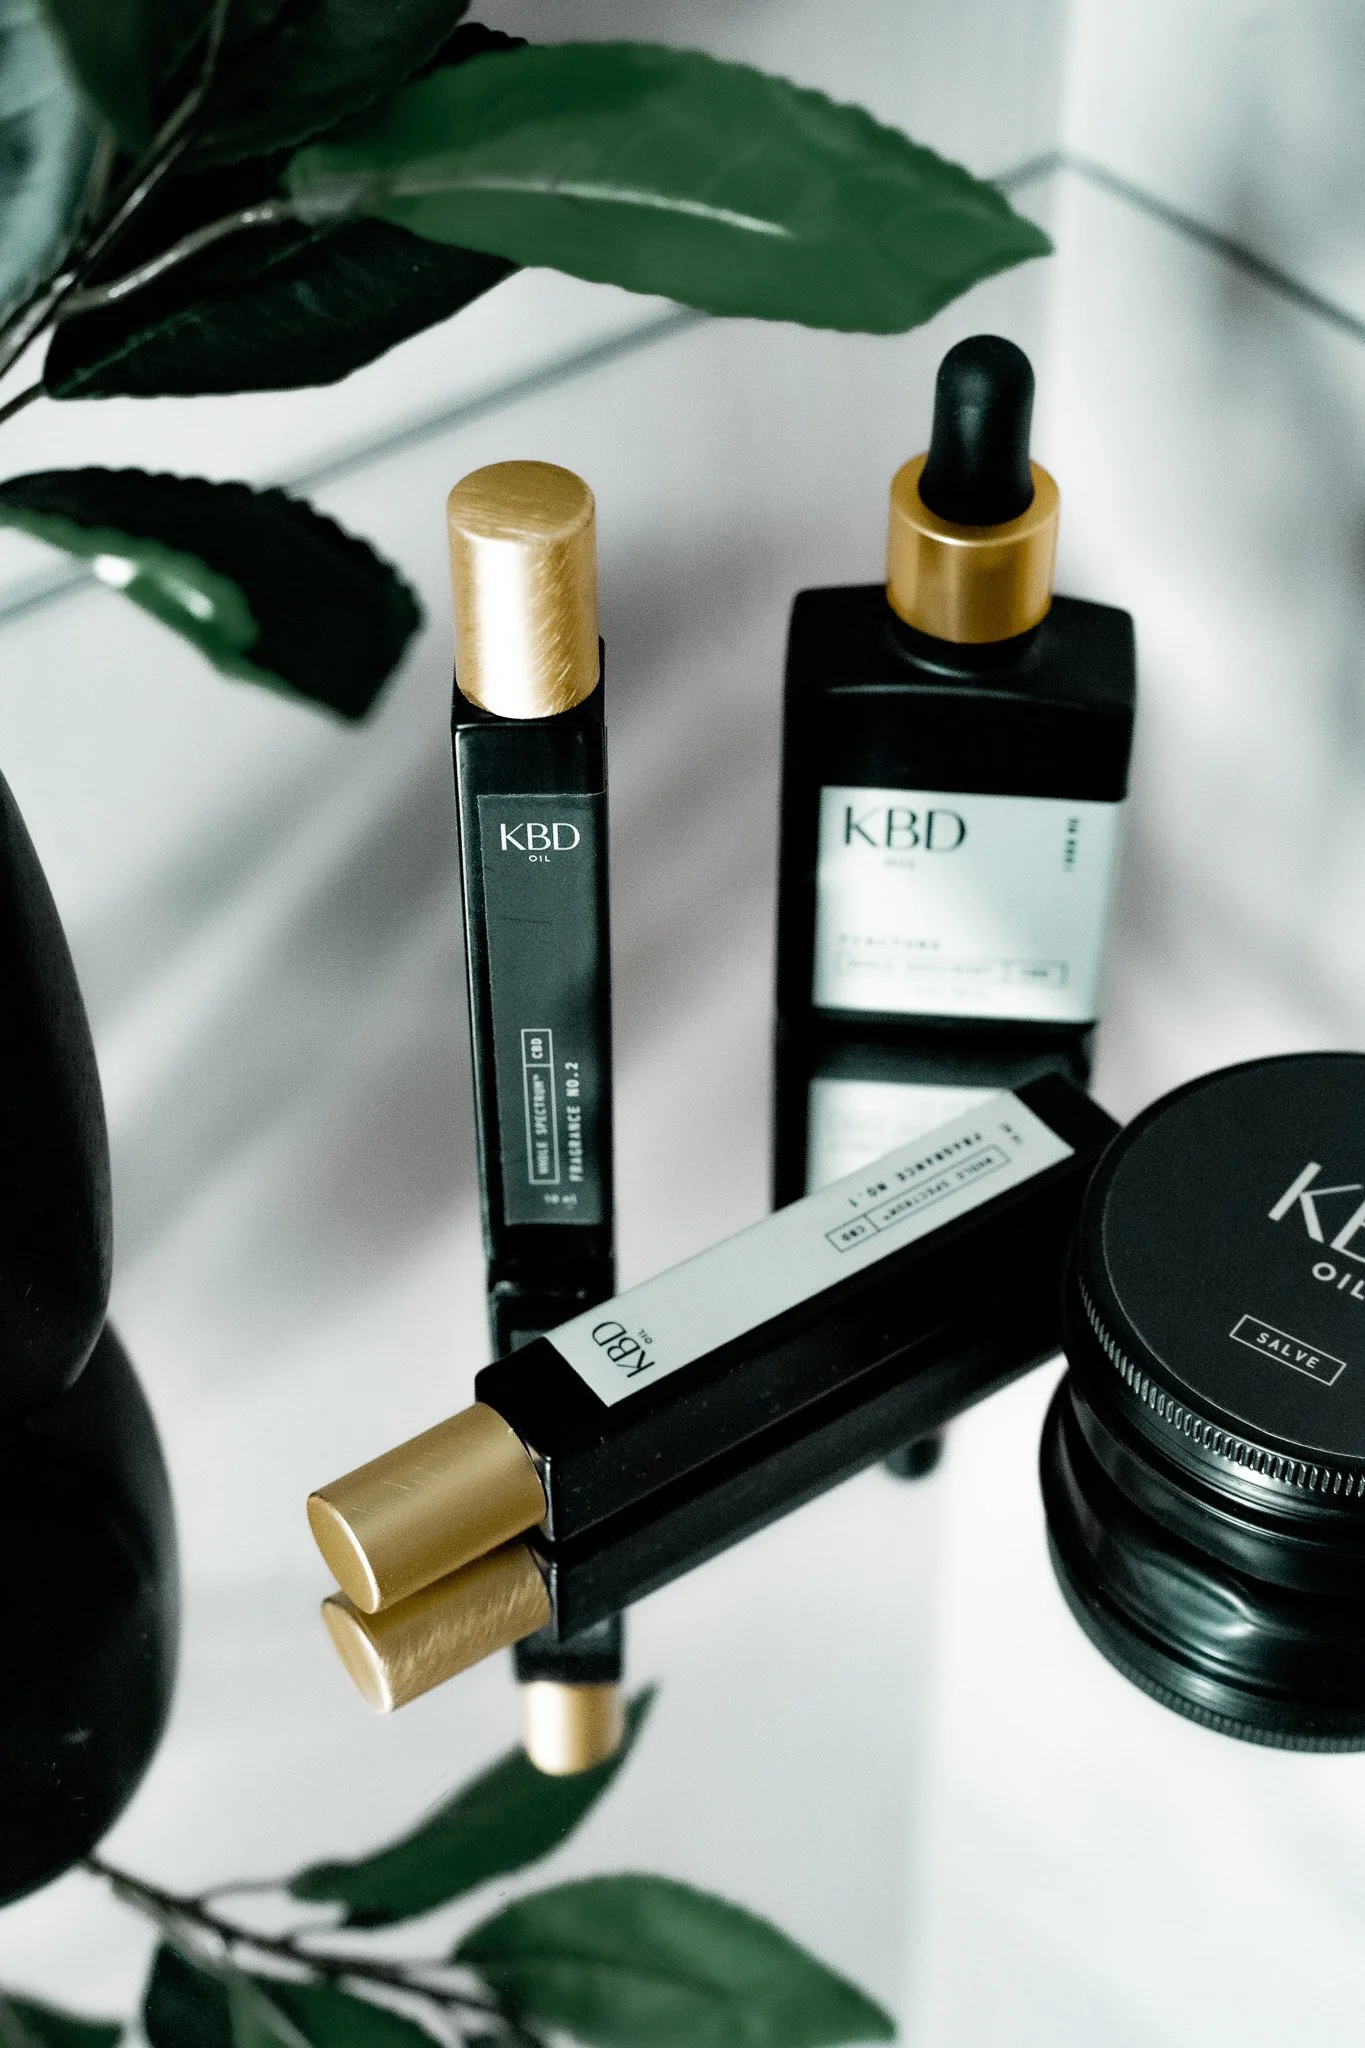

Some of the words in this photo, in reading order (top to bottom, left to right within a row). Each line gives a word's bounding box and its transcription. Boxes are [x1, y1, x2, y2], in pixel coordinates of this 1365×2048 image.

[500, 823, 580, 851] KBD
[844, 806, 967, 852] KBD
[528, 855, 551, 863] OIL
[530, 1037, 544, 1059] CBD
[564, 1061, 580, 1097] NO.2
[566, 1106, 583, 1182] FRAGRANCE
[1312, 1262, 1365, 1300] OIL
[592, 1321, 655, 1378] KBD
[639, 1329, 653, 1345] OIL
[1256, 1332, 1319, 1369] SALVE
